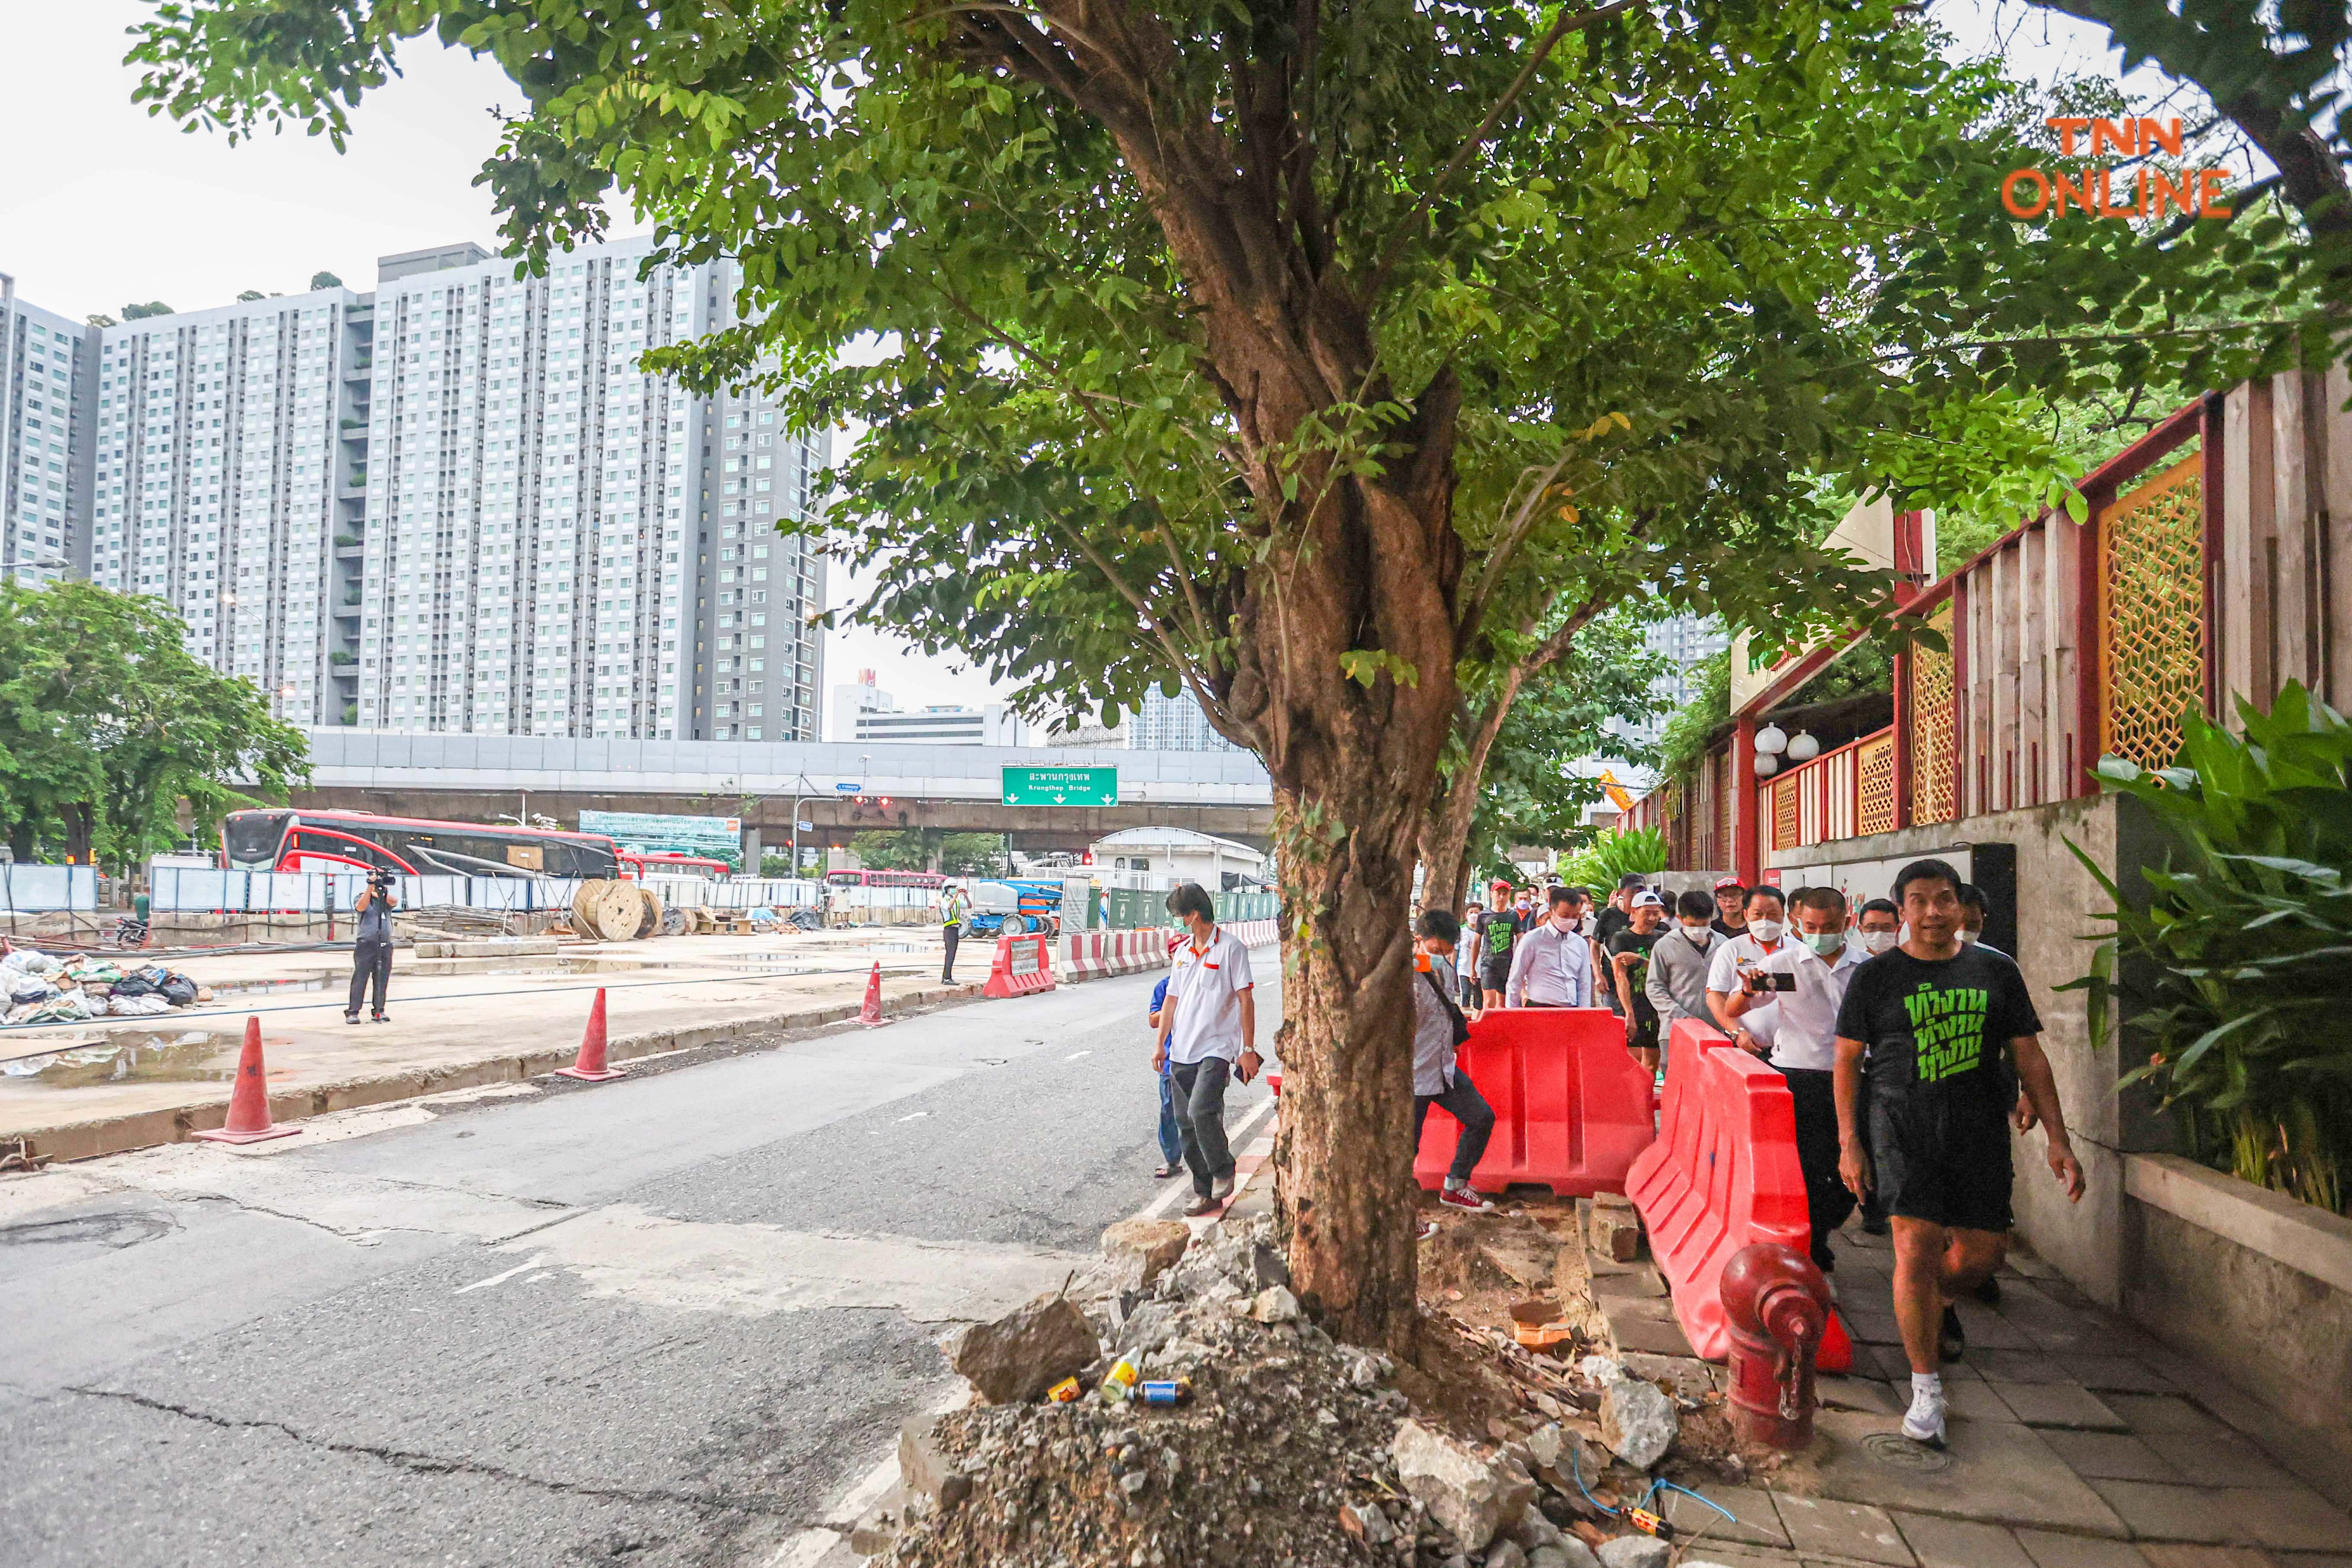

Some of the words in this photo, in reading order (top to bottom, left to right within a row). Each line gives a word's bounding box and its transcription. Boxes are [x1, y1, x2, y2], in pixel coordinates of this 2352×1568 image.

[1029, 773, 1090, 784] สะพานกรุงเทพ
[1904, 983, 1988, 1027] ทำงาน
[1913, 1014, 1986, 1053] ทำงาน
